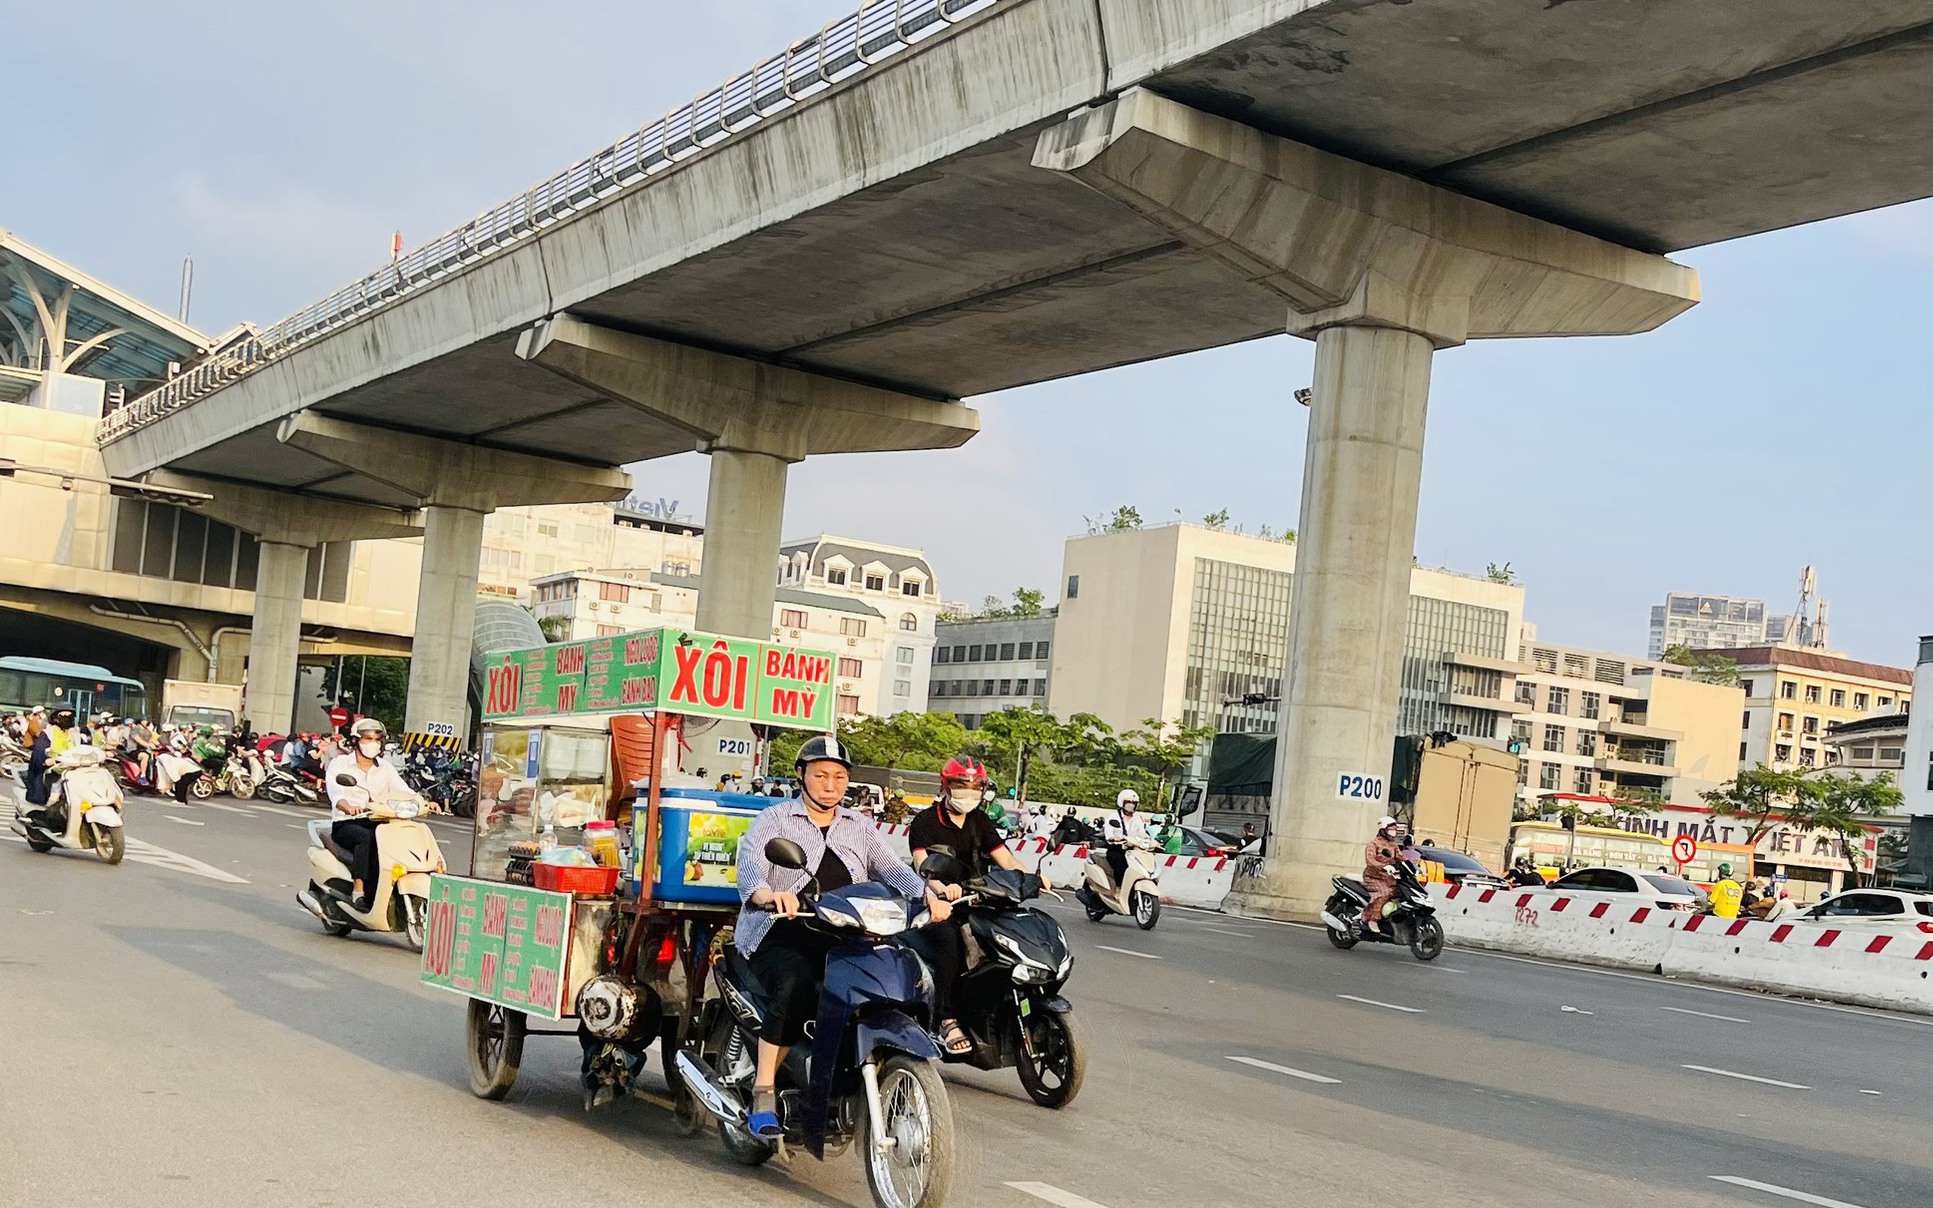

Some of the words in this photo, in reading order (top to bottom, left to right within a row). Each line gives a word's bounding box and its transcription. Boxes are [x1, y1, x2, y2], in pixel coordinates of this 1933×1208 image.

[669, 640, 749, 711] XÔI
[766, 648, 831, 684] BÁNH
[486, 655, 519, 714] XÔI
[428, 723, 453, 735] P202
[719, 739, 750, 755] P201
[1339, 775, 1382, 800] P200
[1677, 815, 1734, 844] MẮT
[1725, 884, 1740, 898] be
